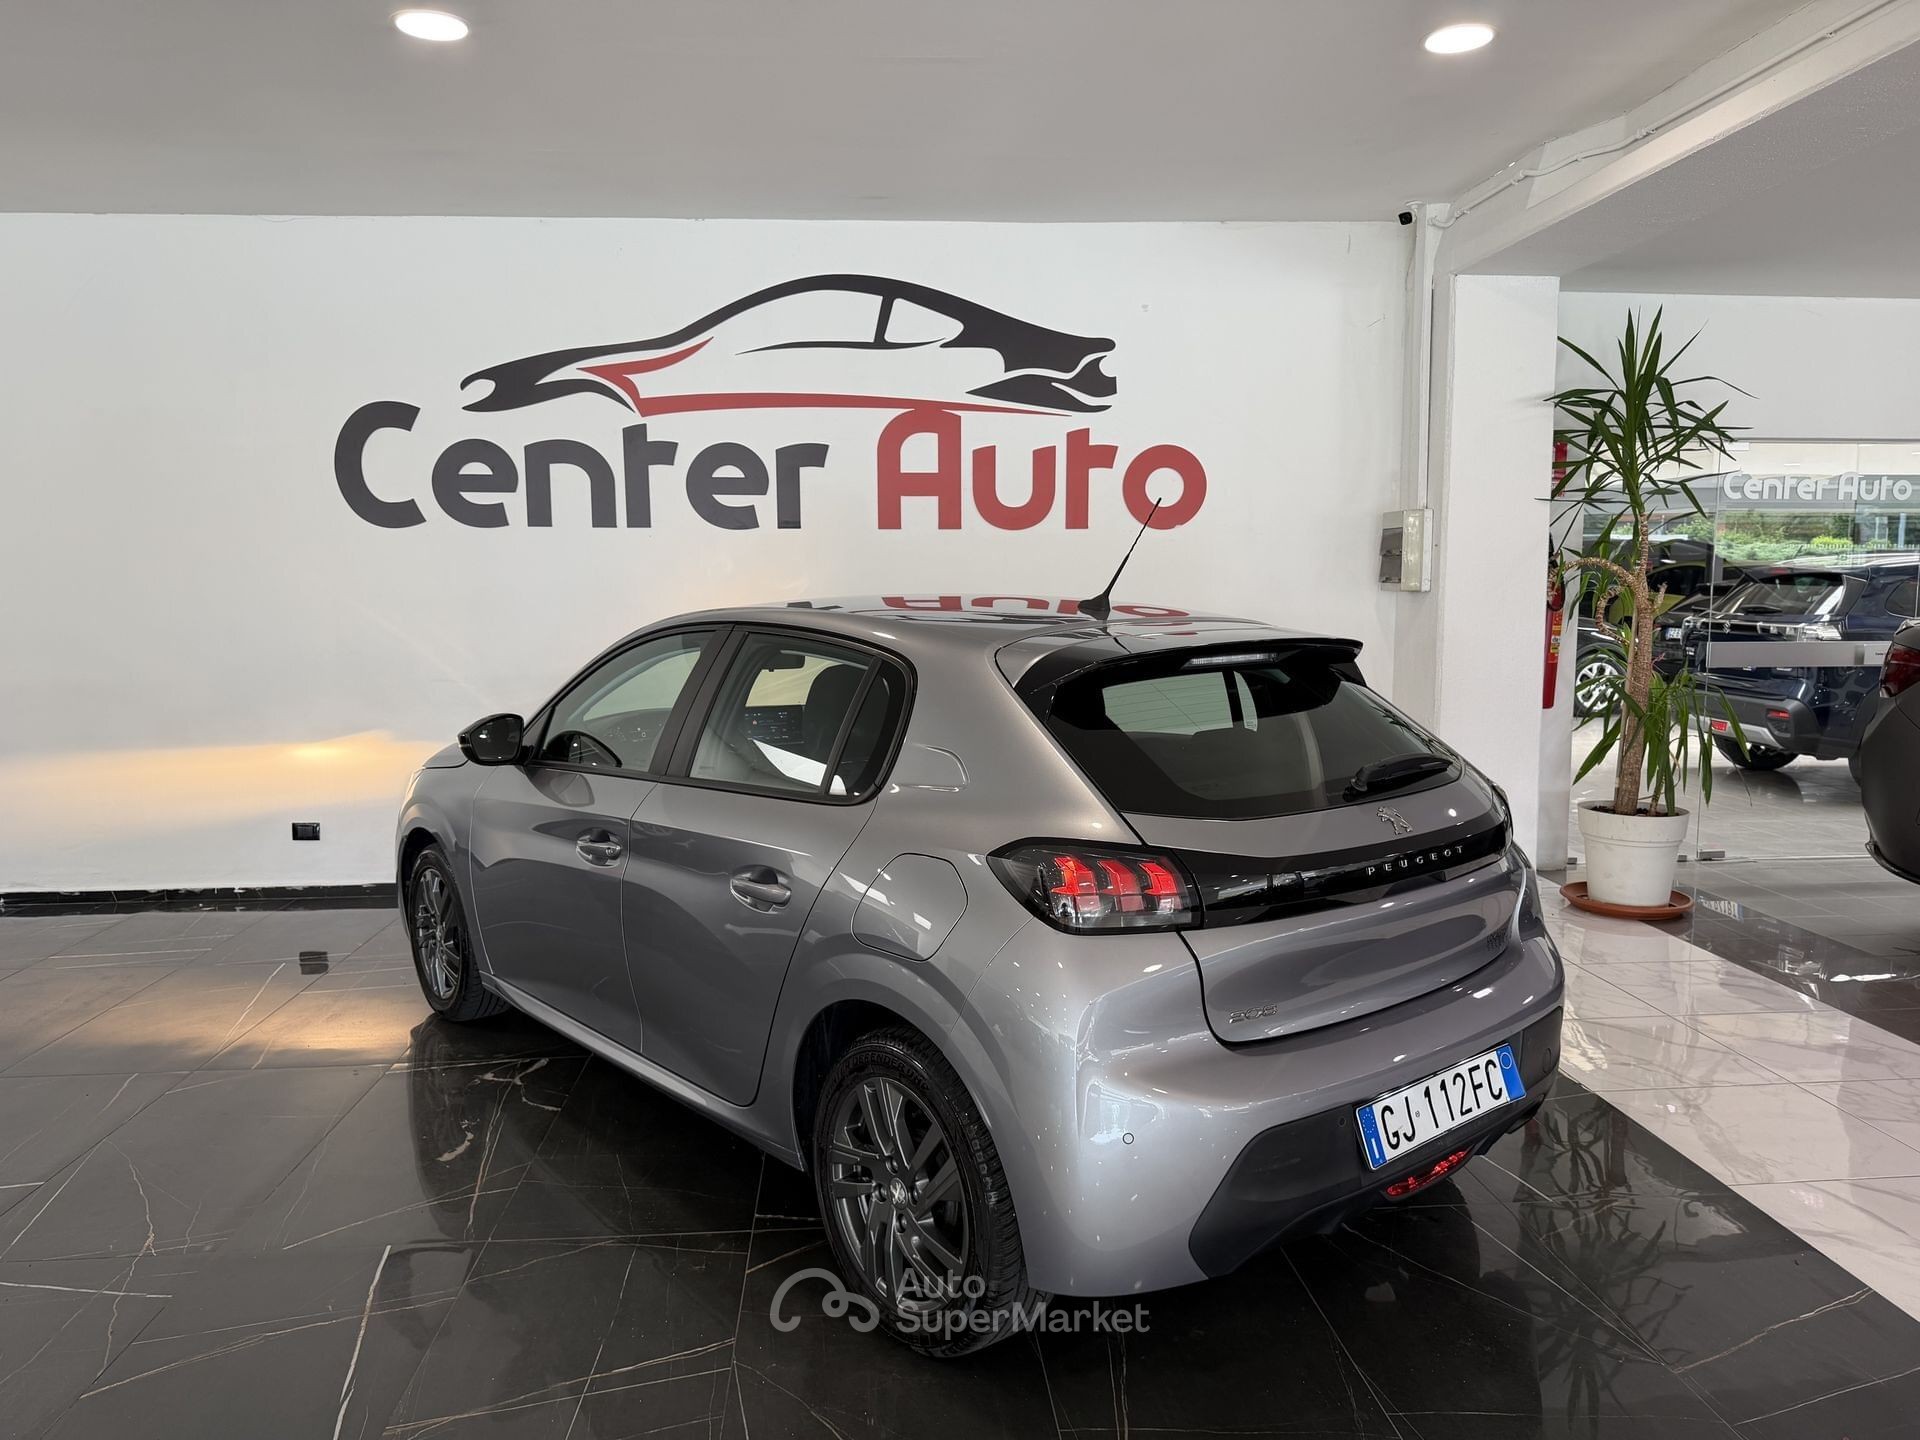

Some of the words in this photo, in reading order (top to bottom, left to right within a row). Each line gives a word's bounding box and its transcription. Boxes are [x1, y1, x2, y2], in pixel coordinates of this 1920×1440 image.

[334, 400, 829, 529] Center
[877, 407, 1208, 531] Auto
[1723, 472, 1829, 500] Center
[1837, 472, 1913, 500] Auto
[1367, 845, 1465, 876] PEUGEOT
[1380, 1059, 1503, 1151] GJ112FC
